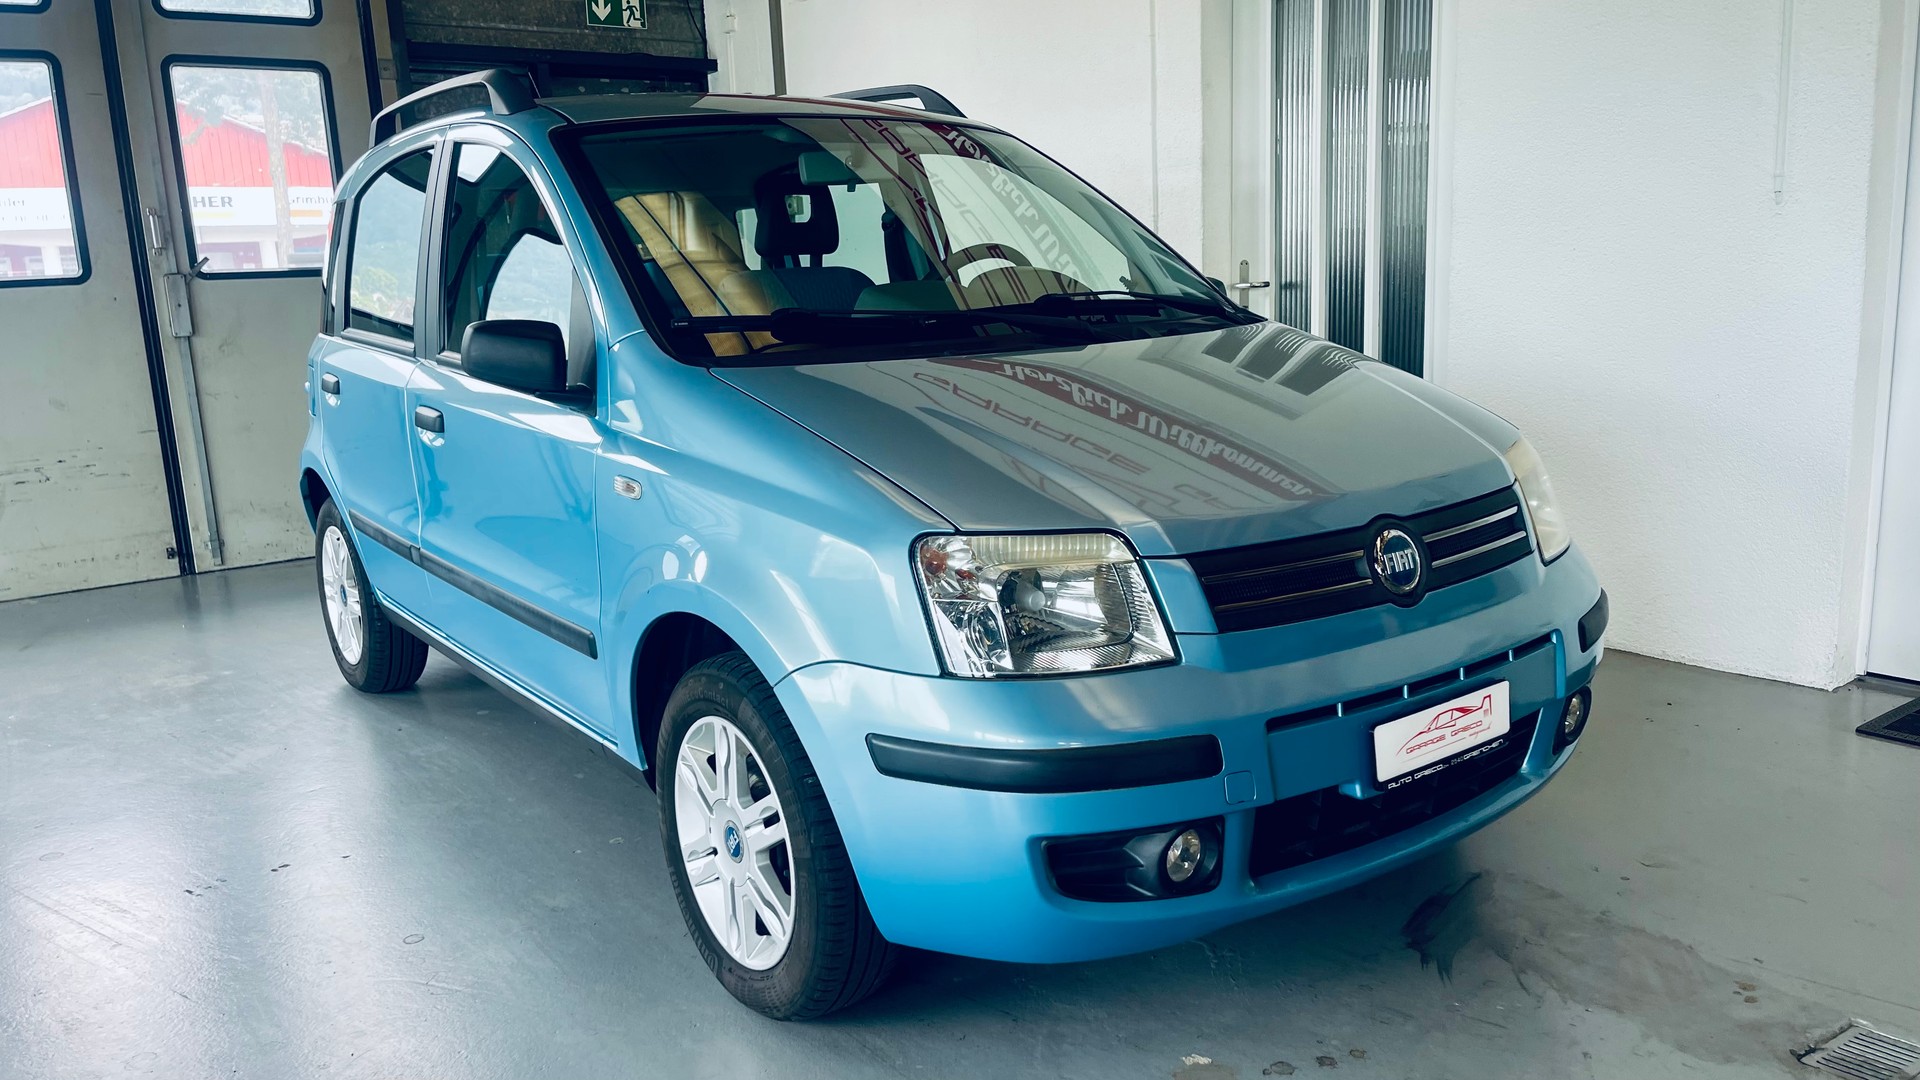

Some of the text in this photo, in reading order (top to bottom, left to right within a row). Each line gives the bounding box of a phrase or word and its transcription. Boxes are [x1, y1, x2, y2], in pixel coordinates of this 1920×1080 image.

[1384, 548, 1415, 575] FIAT
[1406, 734, 1446, 755] GARAGE
[1451, 720, 1483, 737] GRECO
[1388, 776, 1413, 790] AUTO
[1414, 764, 1443, 780] GRECO
[1463, 739, 1504, 760] GRENCHEN
